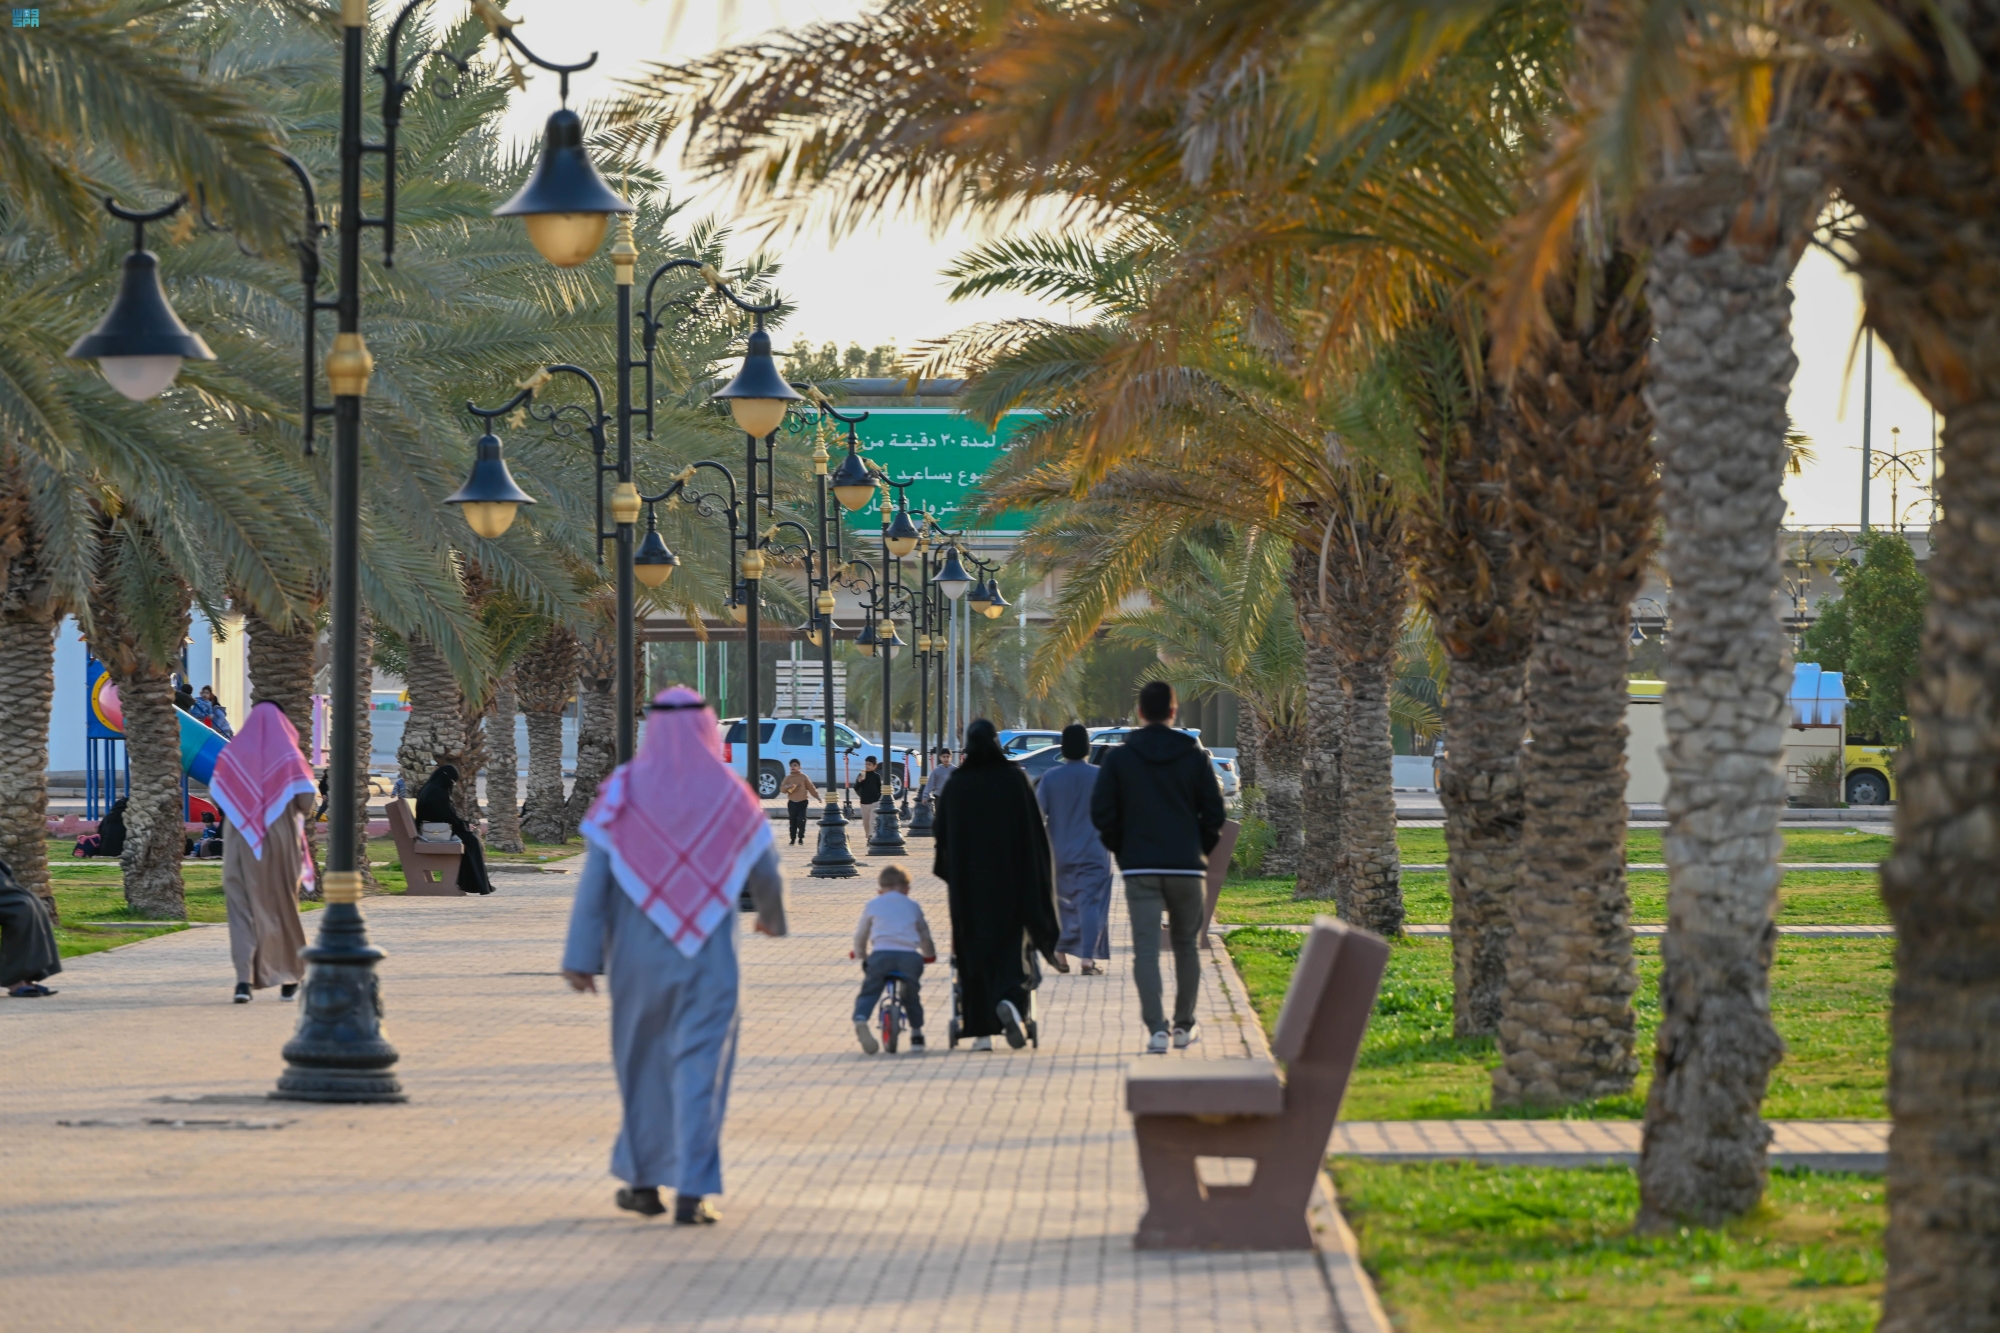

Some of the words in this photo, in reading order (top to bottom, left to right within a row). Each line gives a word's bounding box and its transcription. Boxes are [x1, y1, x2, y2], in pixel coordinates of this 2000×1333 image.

[862, 436, 884, 451] من
[888, 432, 937, 451] دقيقة
[940, 433, 956, 446] ٣٠
[960, 434, 996, 448] لمدة
[896, 466, 953, 484] يساعد
